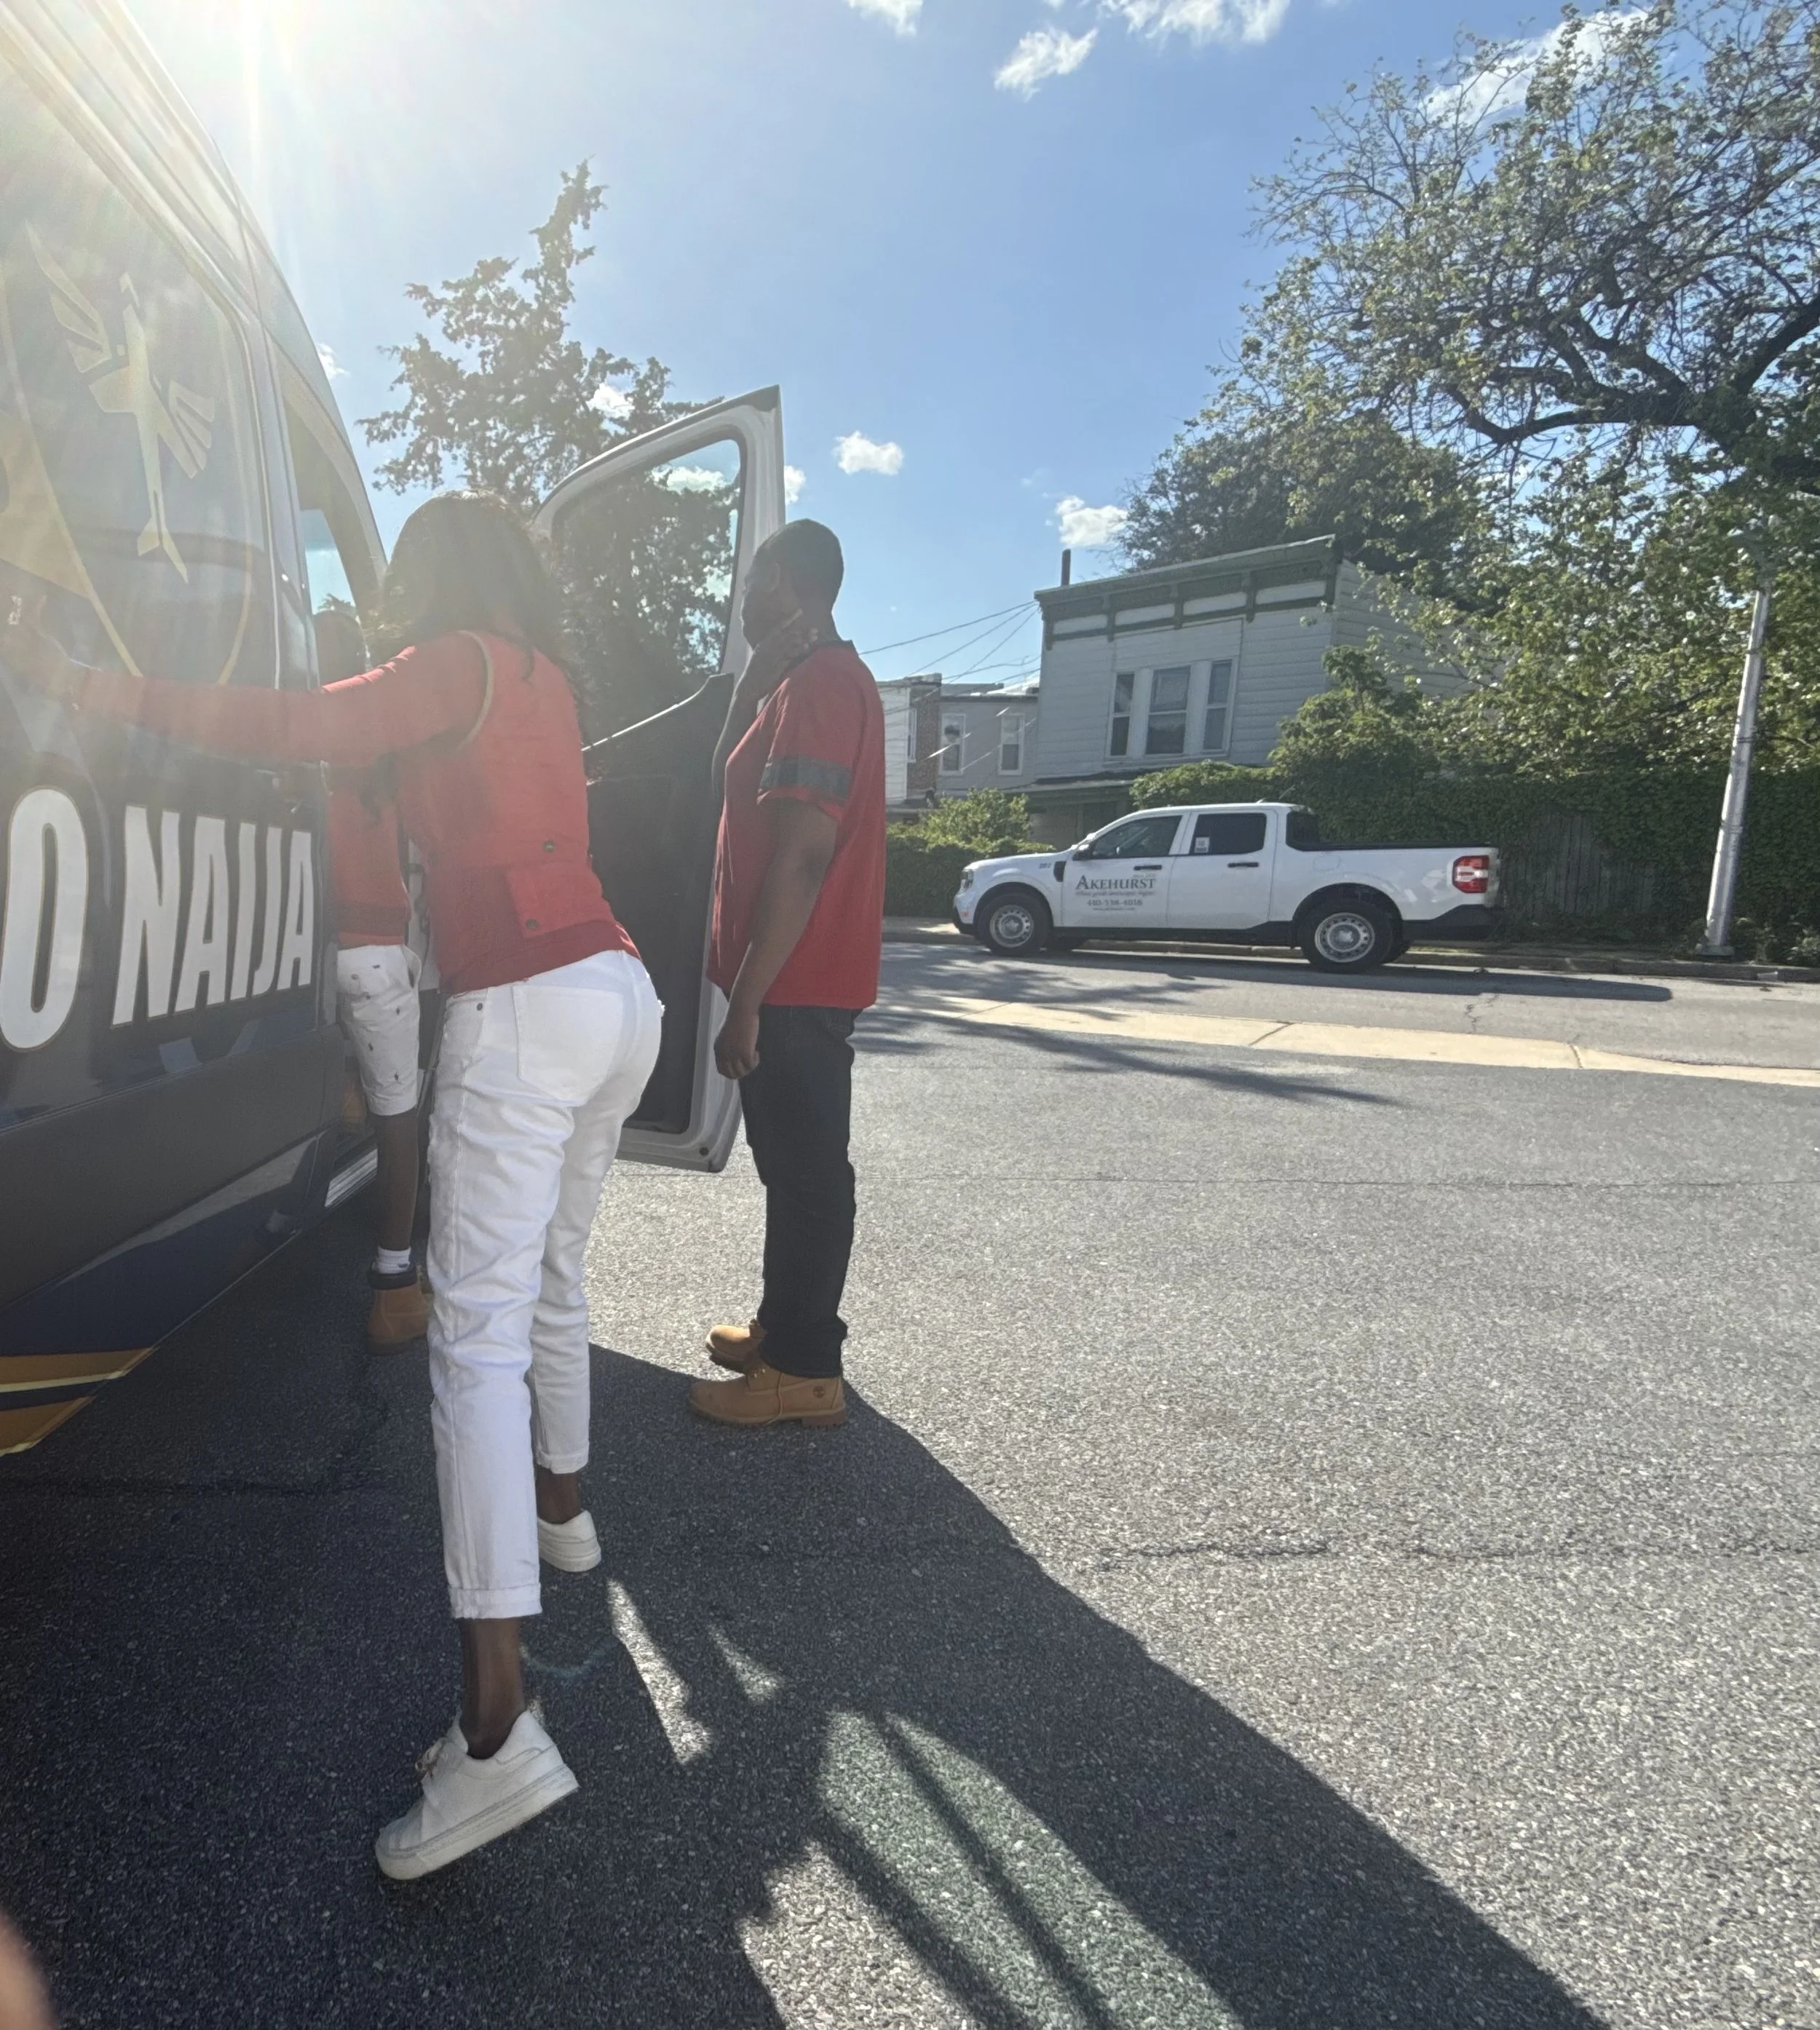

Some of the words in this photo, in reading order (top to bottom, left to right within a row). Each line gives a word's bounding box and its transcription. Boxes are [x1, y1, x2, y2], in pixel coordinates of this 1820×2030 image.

[0, 788, 87, 1050] O
[111, 805, 313, 1027] NAIJA
[1076, 875, 1155, 889] AKEHURST
